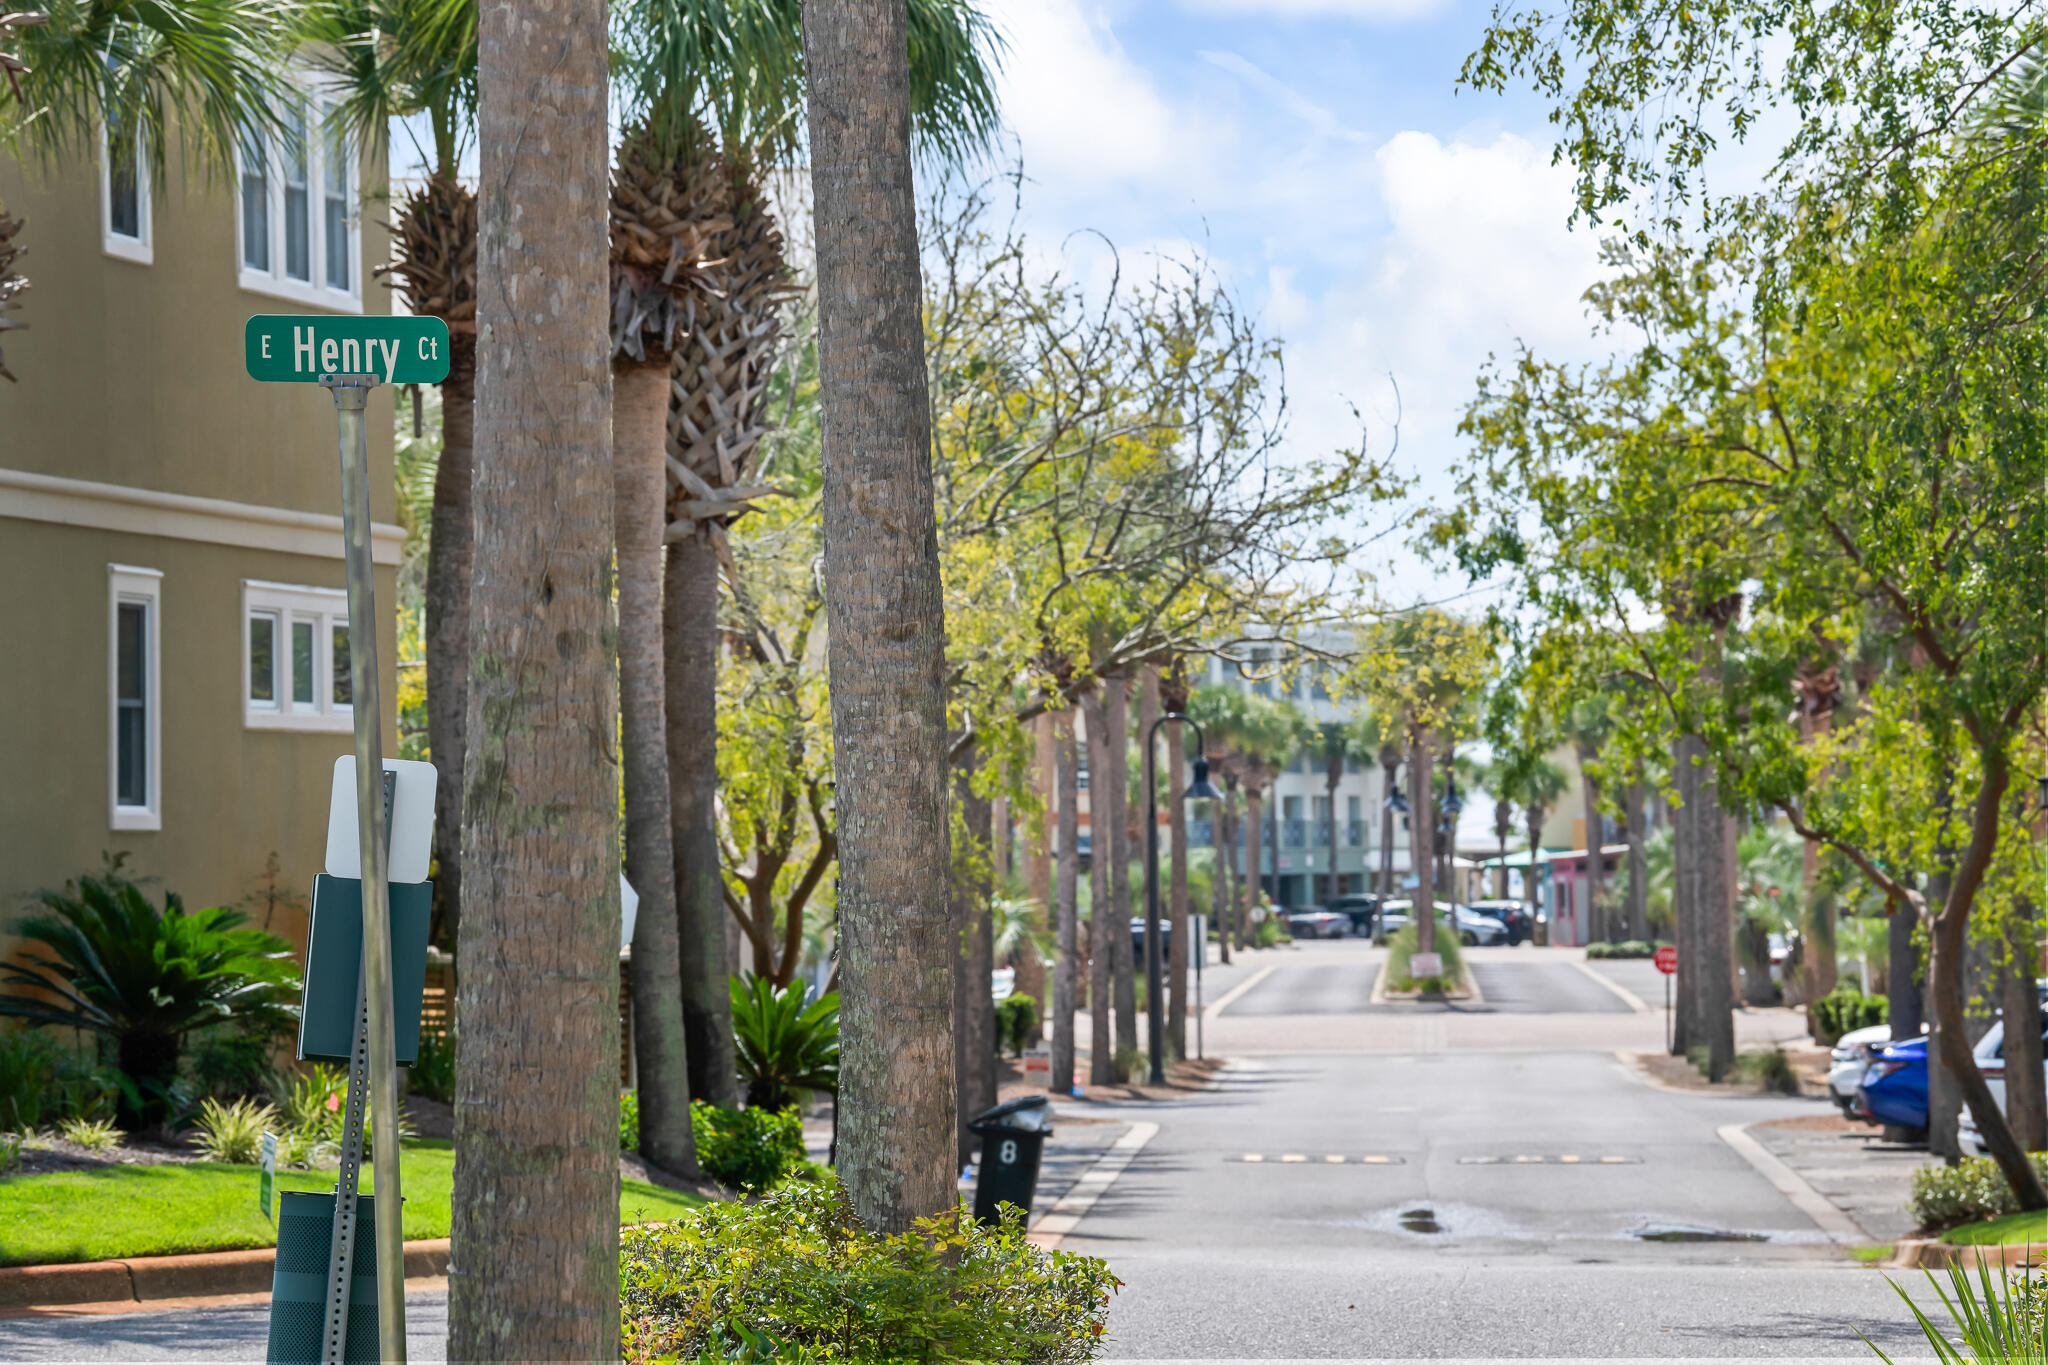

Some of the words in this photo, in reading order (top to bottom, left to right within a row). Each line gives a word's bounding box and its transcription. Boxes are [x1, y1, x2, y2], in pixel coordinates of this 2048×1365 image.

[261, 334, 272, 359] E
[293, 326, 400, 383] Henry
[418, 336, 438, 361] Ct
[1001, 1139, 1017, 1164] 8
